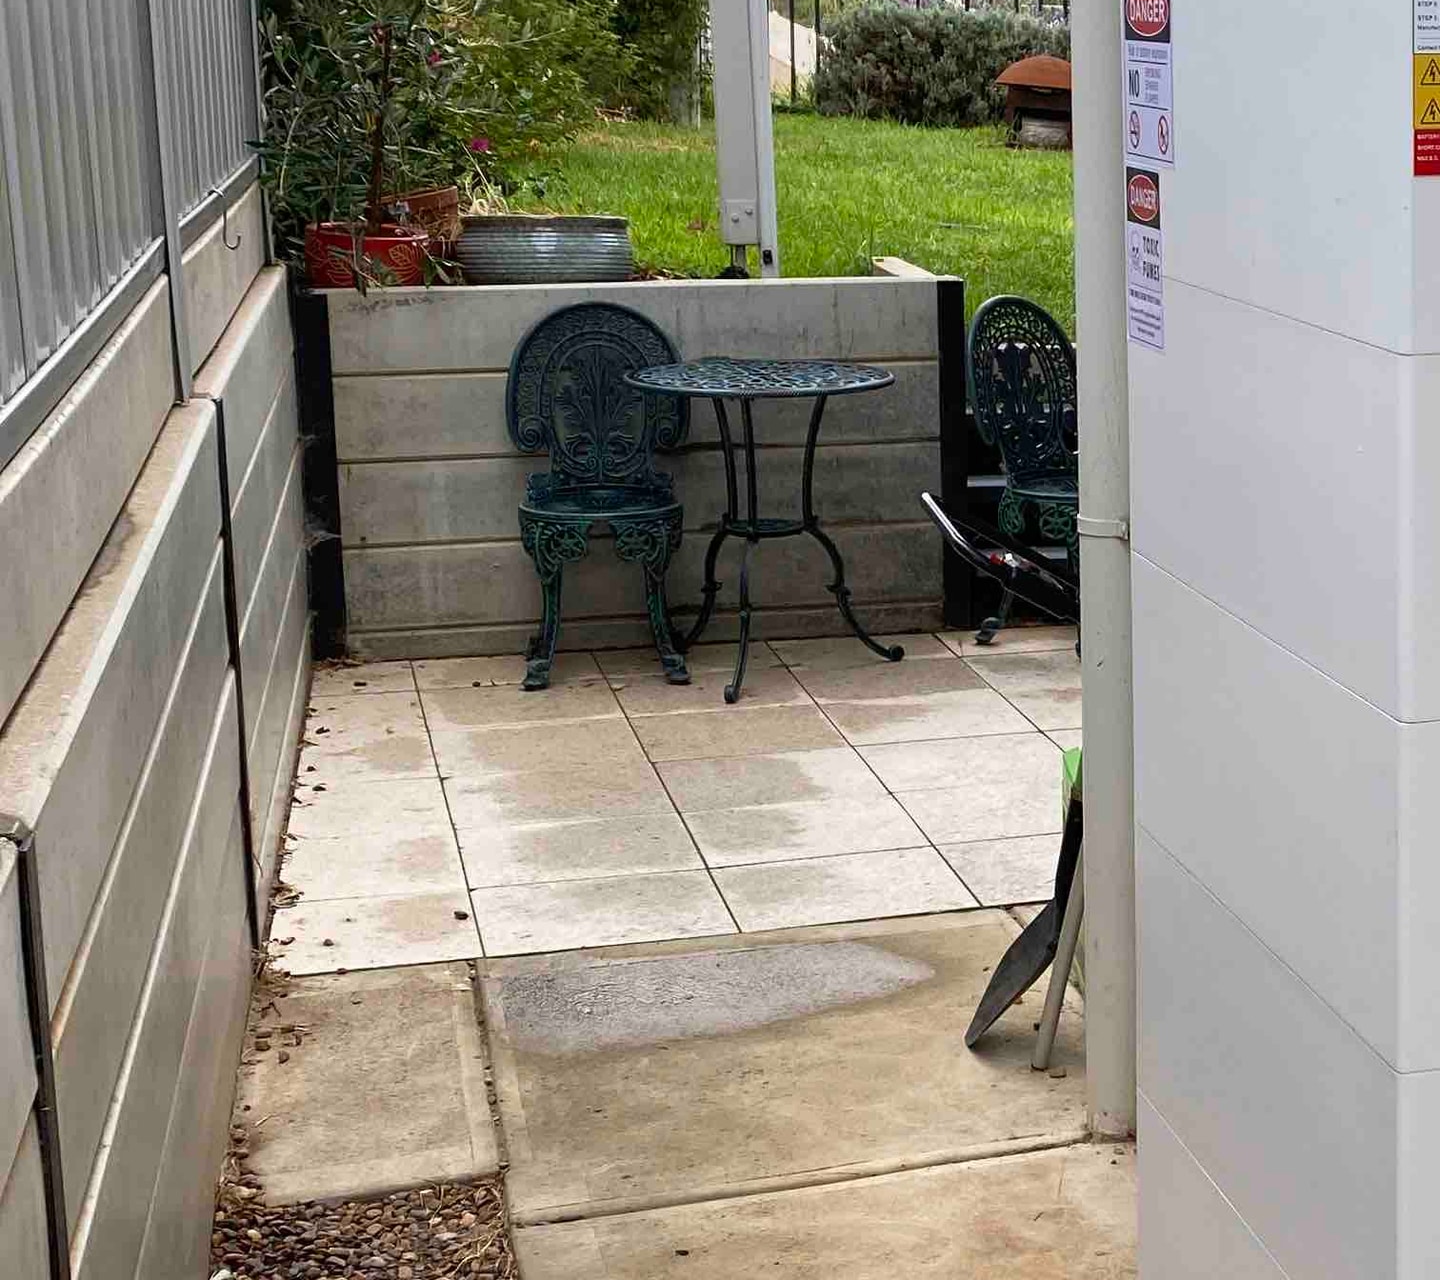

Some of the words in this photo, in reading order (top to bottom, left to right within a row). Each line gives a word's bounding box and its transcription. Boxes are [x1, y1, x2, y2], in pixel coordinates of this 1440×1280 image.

[1129, 0, 1166, 23] DANGER
[1128, 69, 1140, 98] NO
[1130, 184, 1157, 210] DANGER
[1142, 235, 1159, 258] TOXIC
